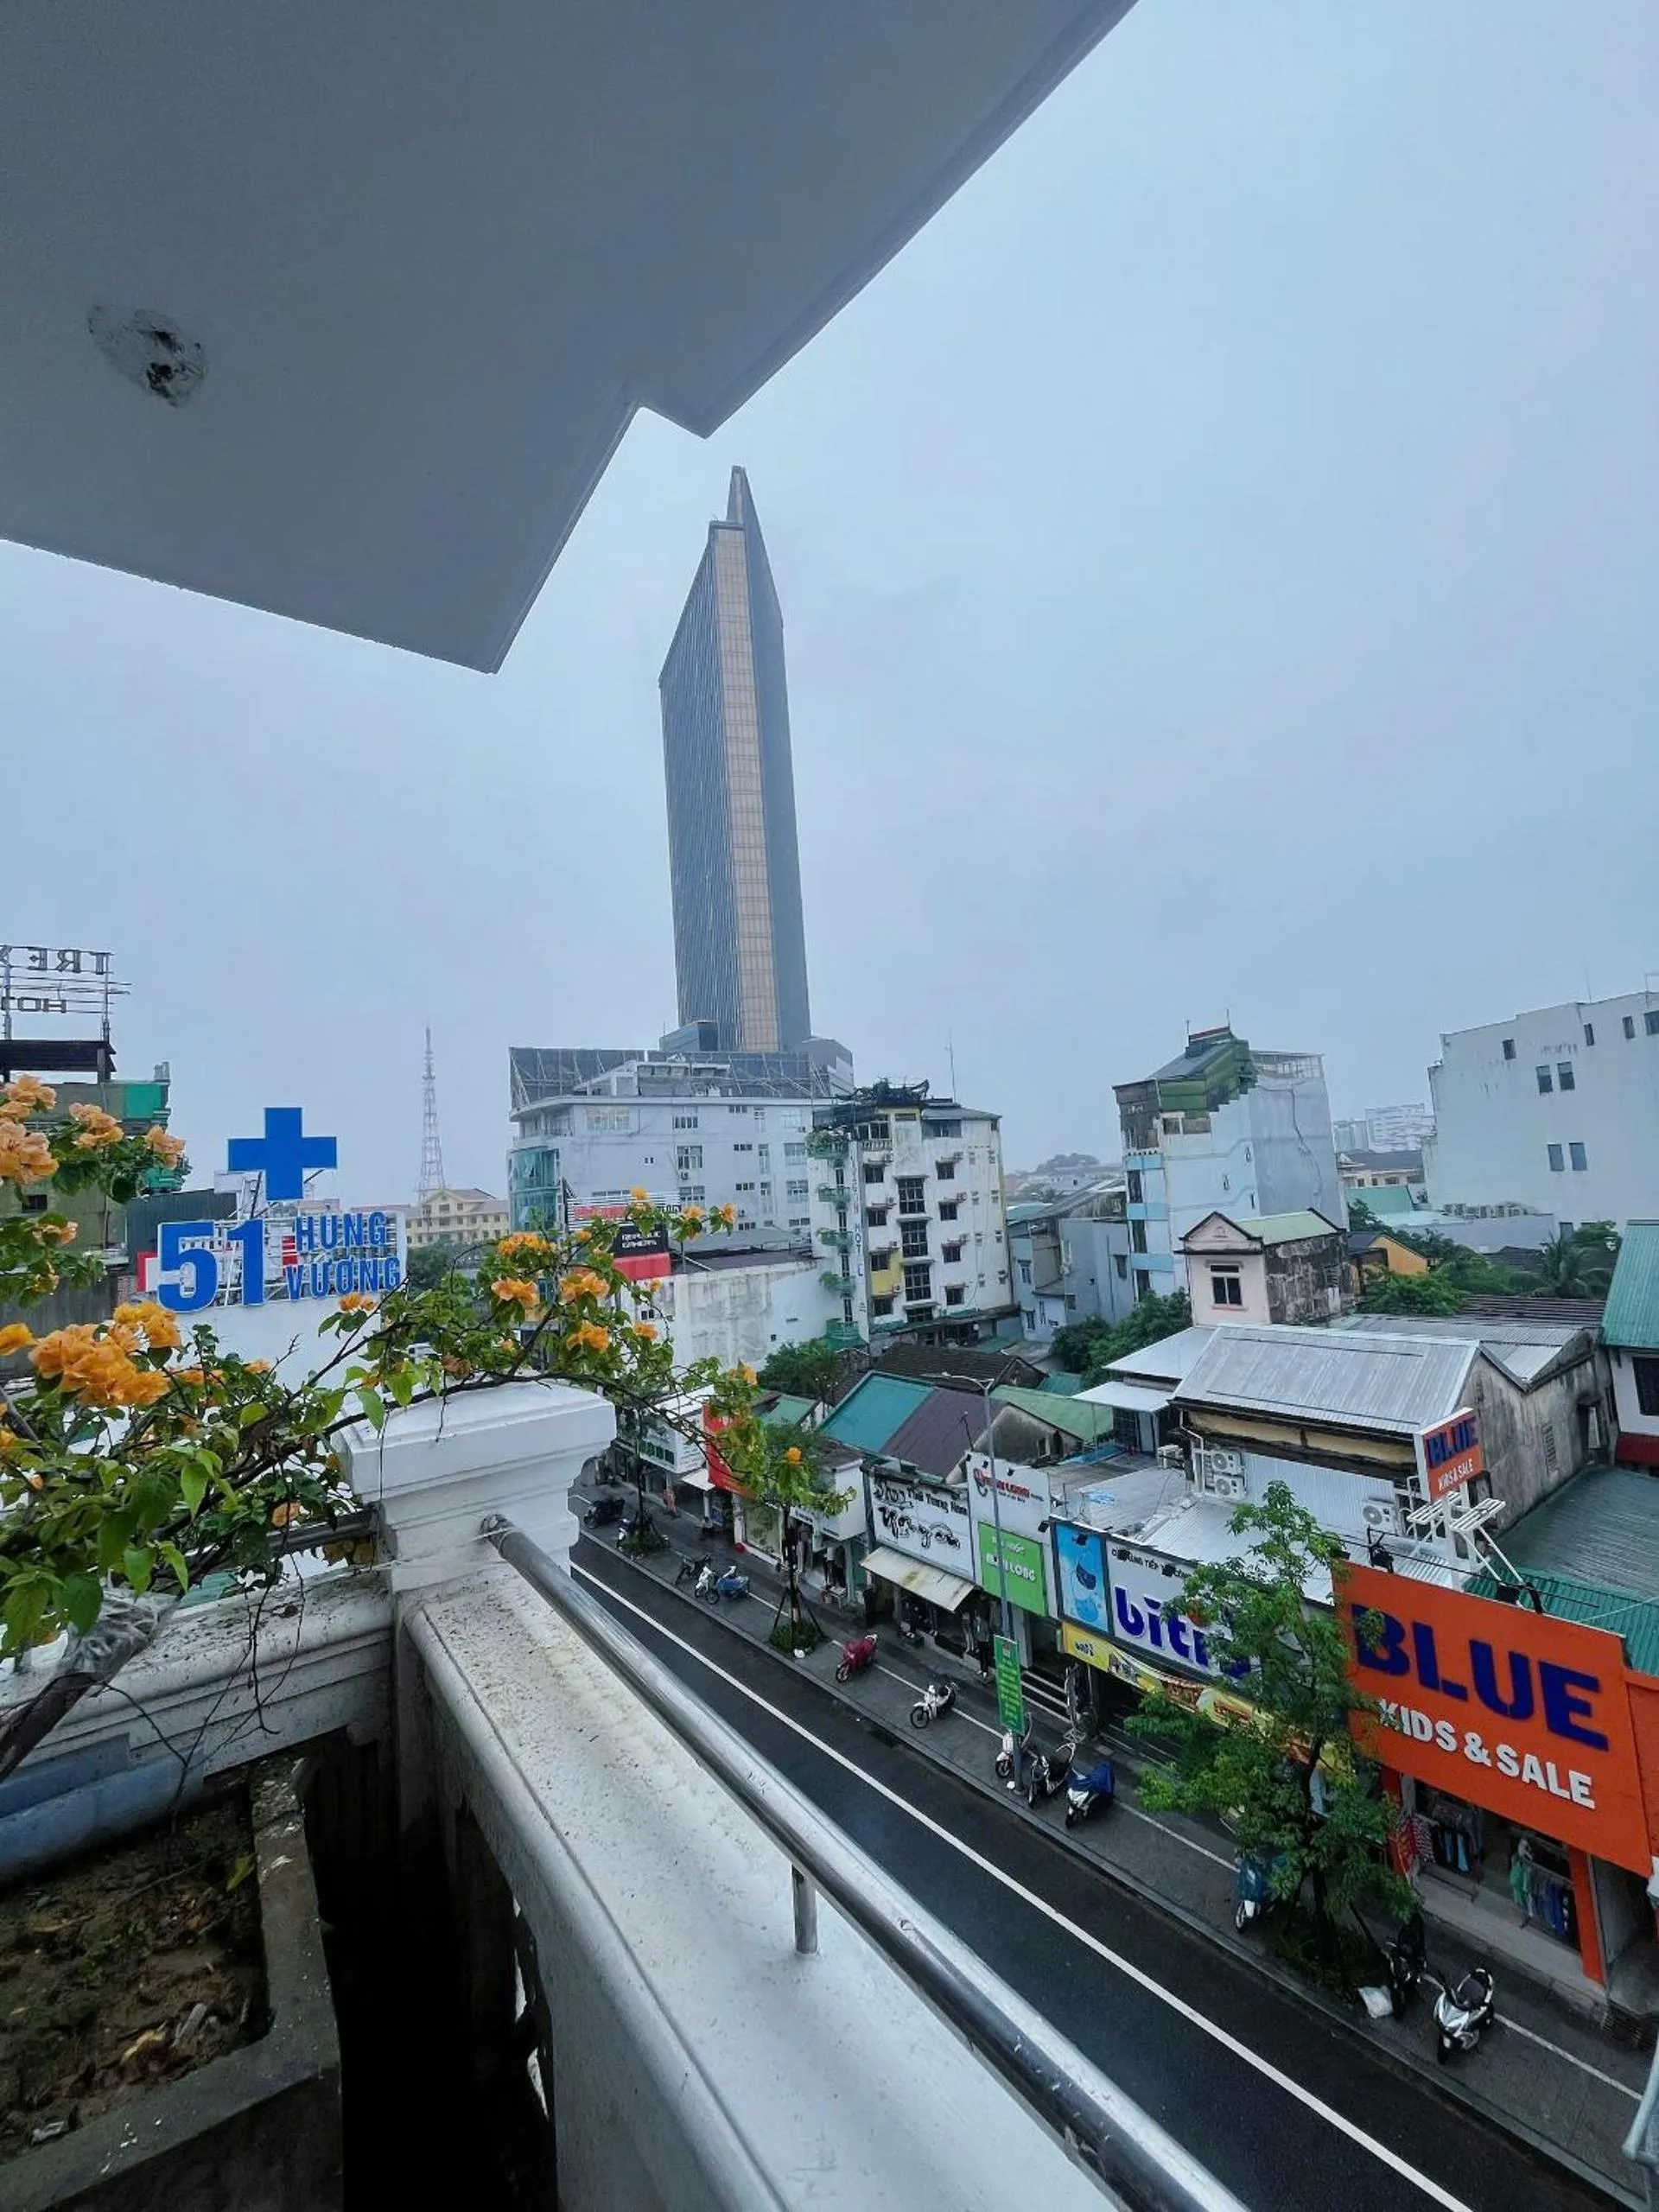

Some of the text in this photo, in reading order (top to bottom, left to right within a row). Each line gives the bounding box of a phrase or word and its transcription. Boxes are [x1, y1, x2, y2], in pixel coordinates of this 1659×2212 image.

[157, 1218, 264, 1313] 51
[1425, 1417, 1478, 1469] BLUE
[1351, 1603, 1609, 1751] BLUE
[1379, 1699, 1596, 1810] KIDS & SALE
